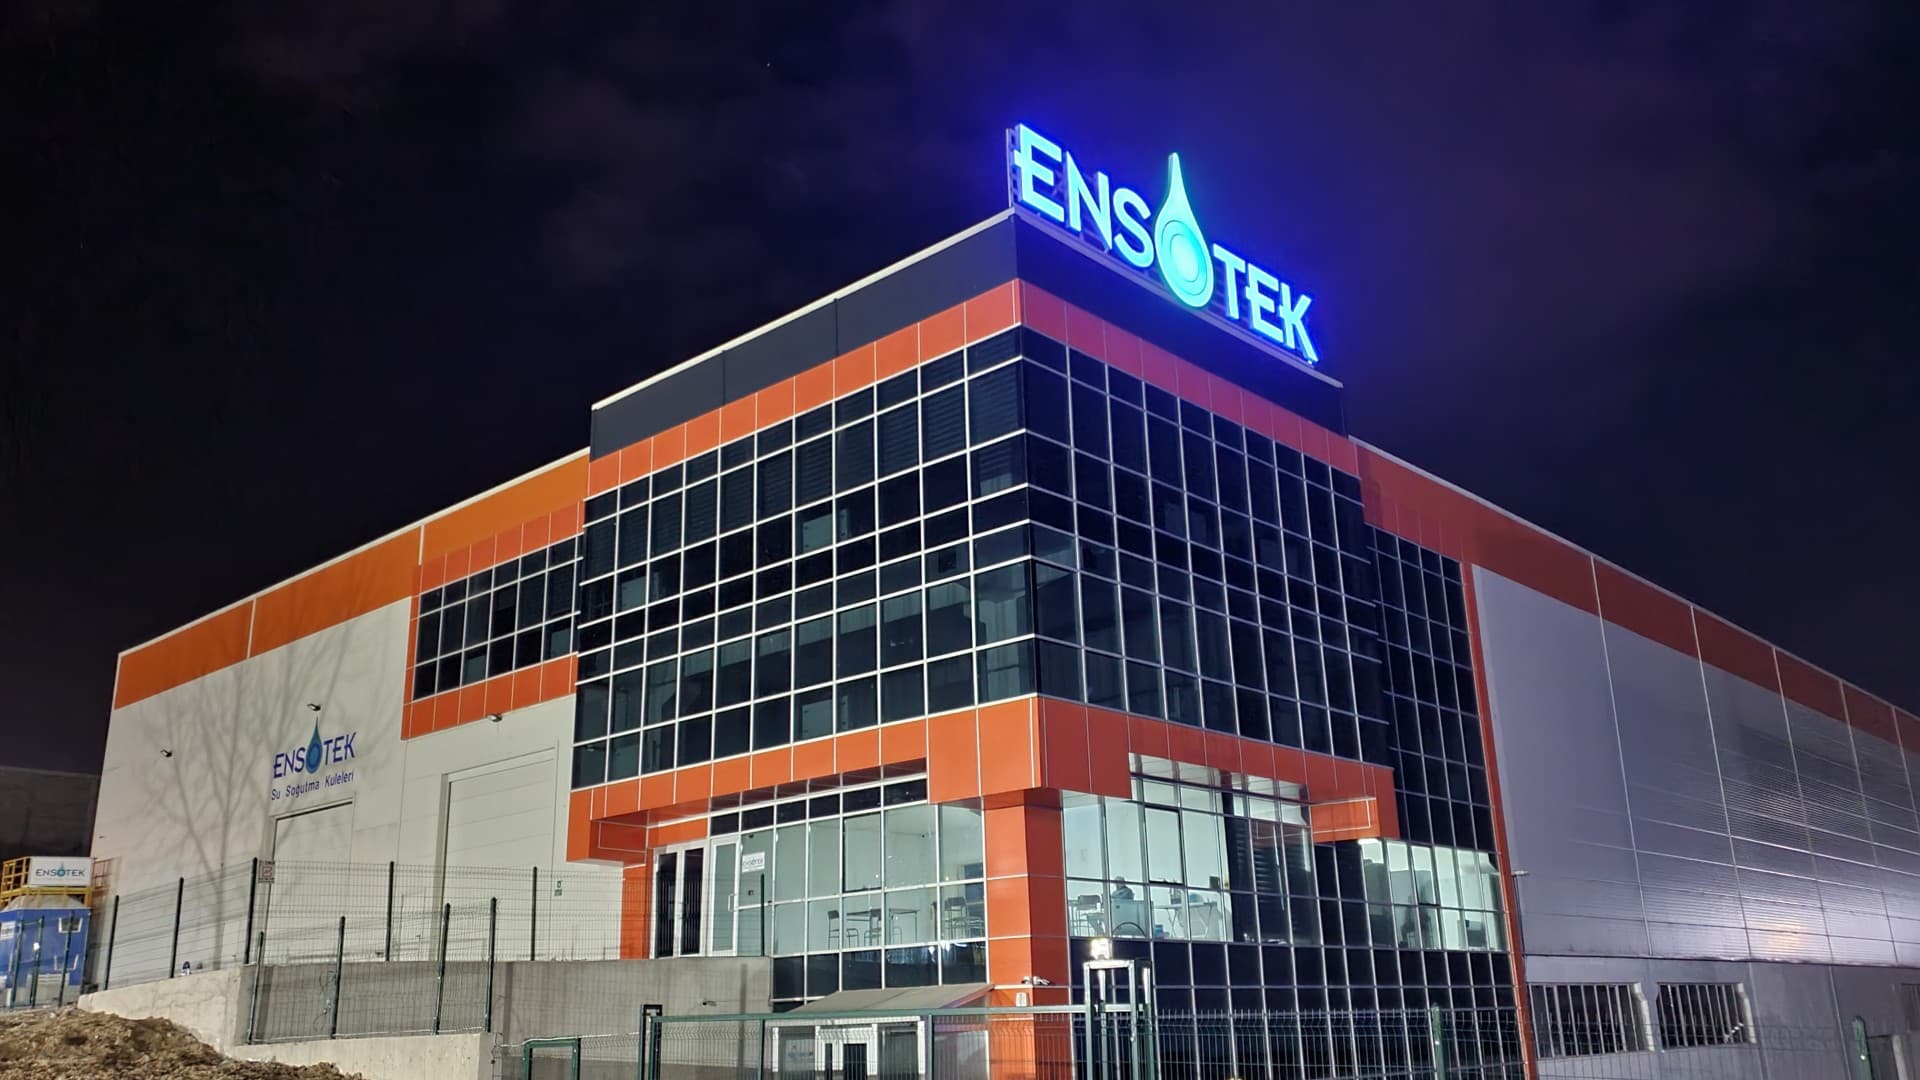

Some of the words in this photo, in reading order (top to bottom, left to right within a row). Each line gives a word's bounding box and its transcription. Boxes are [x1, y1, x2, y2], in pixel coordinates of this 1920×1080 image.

[1014, 123, 1318, 363] ENSOTEK
[273, 716, 356, 778] ENSOTEK
[271, 788, 281, 801] Su
[325, 770, 354, 787] Kuleleri
[35, 864, 85, 877] ENSOTEK
